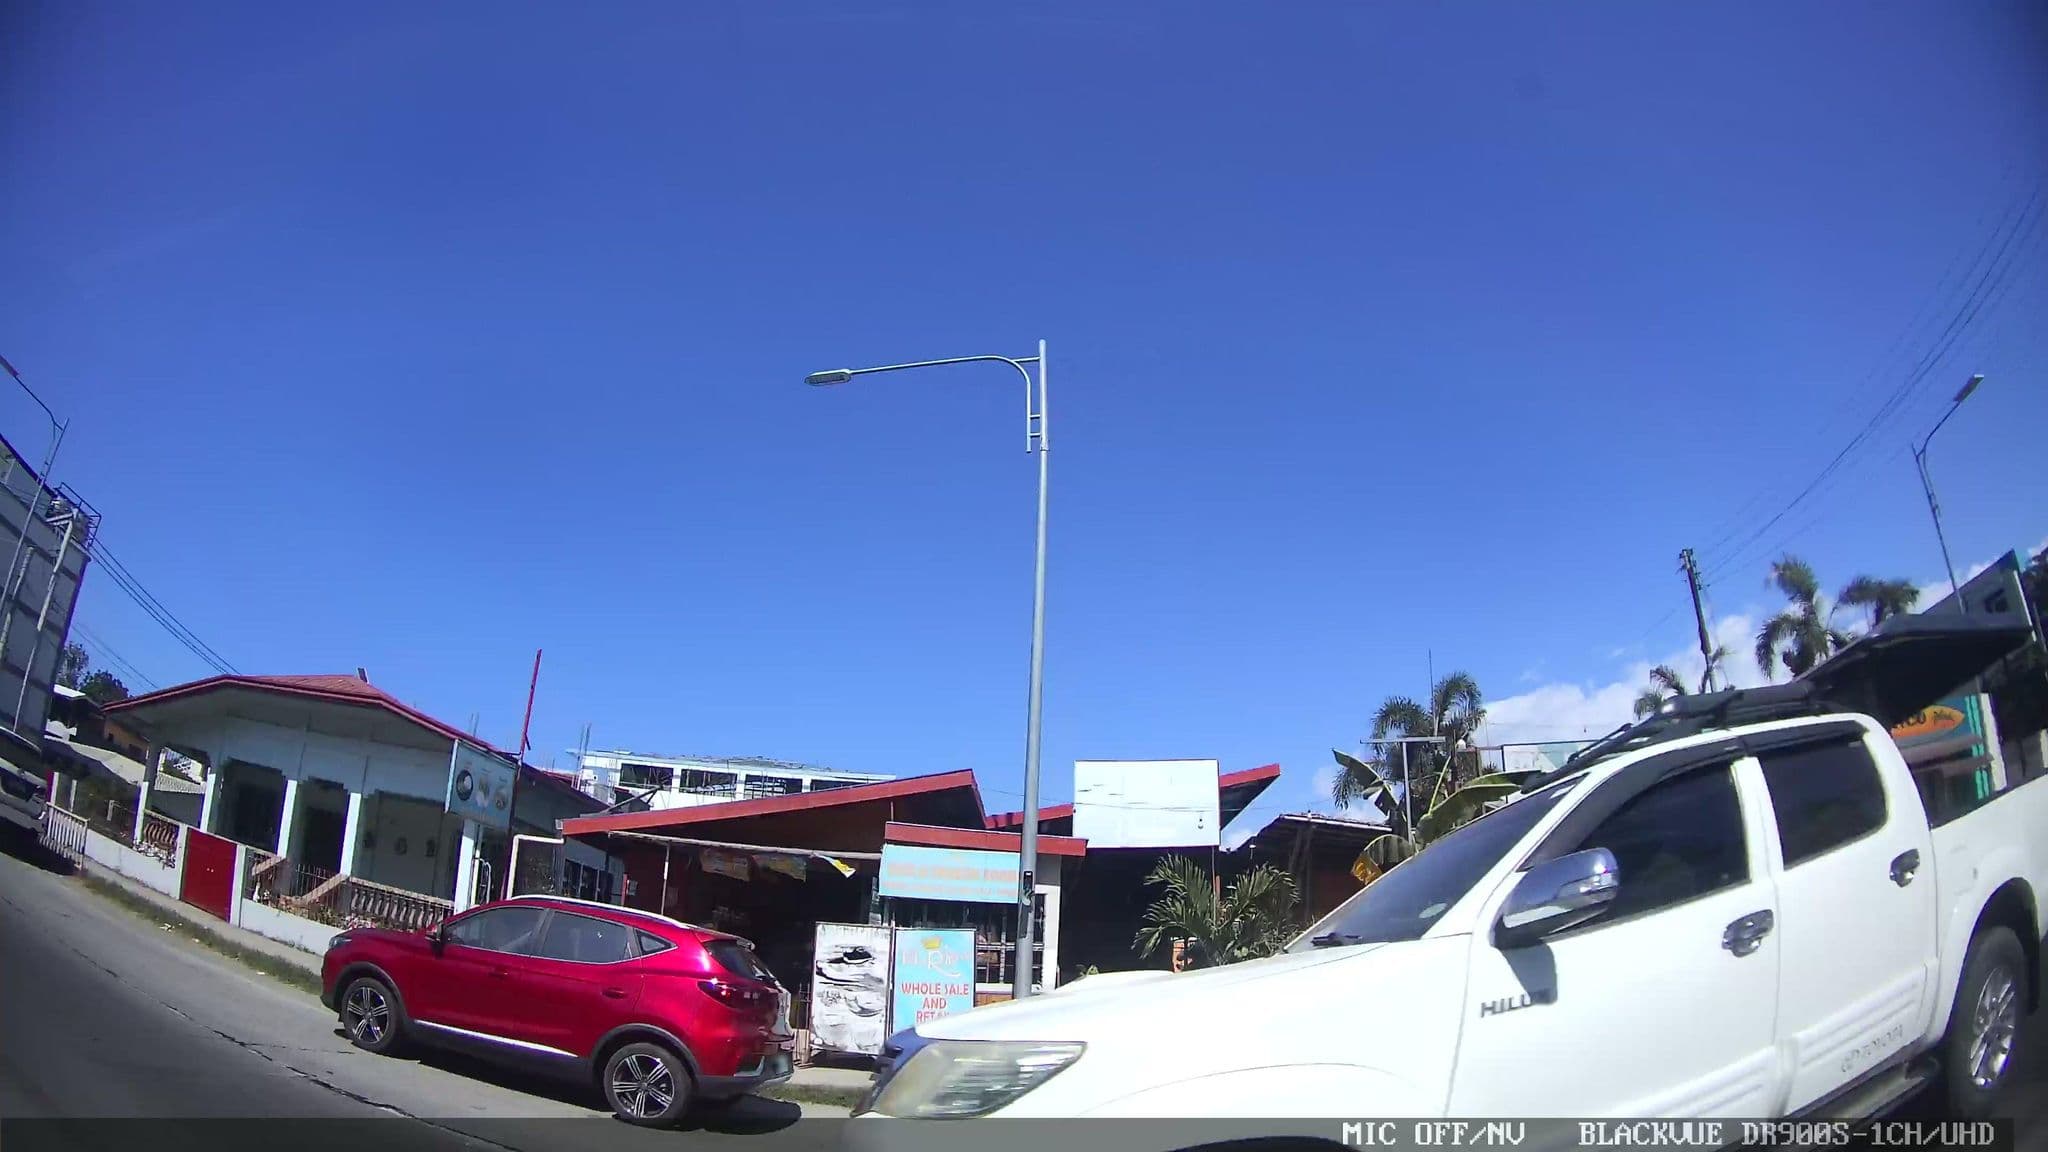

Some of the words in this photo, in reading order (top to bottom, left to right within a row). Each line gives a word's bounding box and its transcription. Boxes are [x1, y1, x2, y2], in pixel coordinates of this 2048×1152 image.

[902, 983, 941, 995] WHOLE
[944, 984, 969, 995] SALE
[922, 997, 947, 1009] AND
